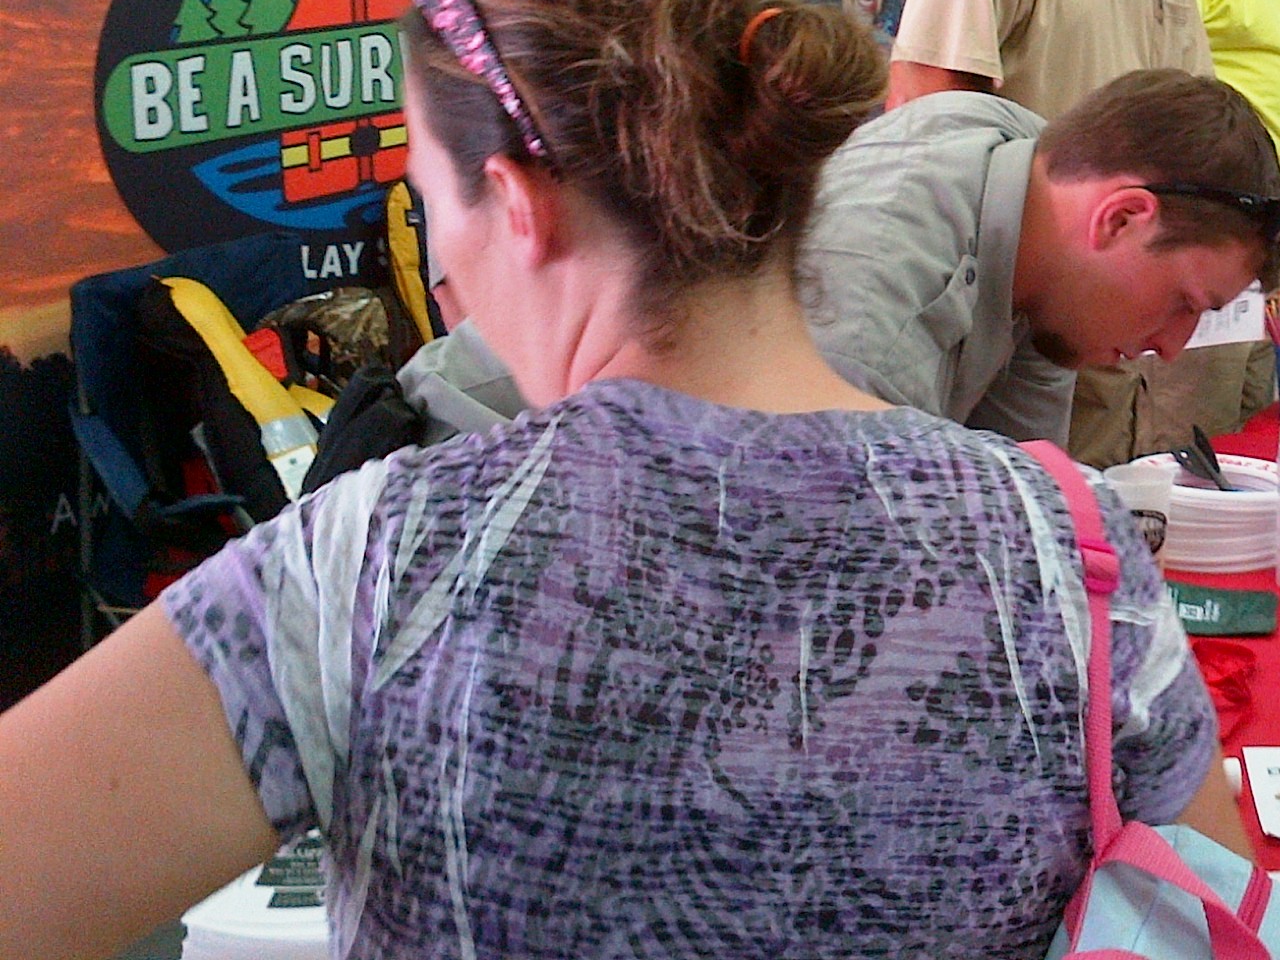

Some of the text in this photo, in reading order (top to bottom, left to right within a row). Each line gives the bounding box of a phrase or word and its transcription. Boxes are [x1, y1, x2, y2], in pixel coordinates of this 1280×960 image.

[130, 34, 396, 141] BE A SUR
